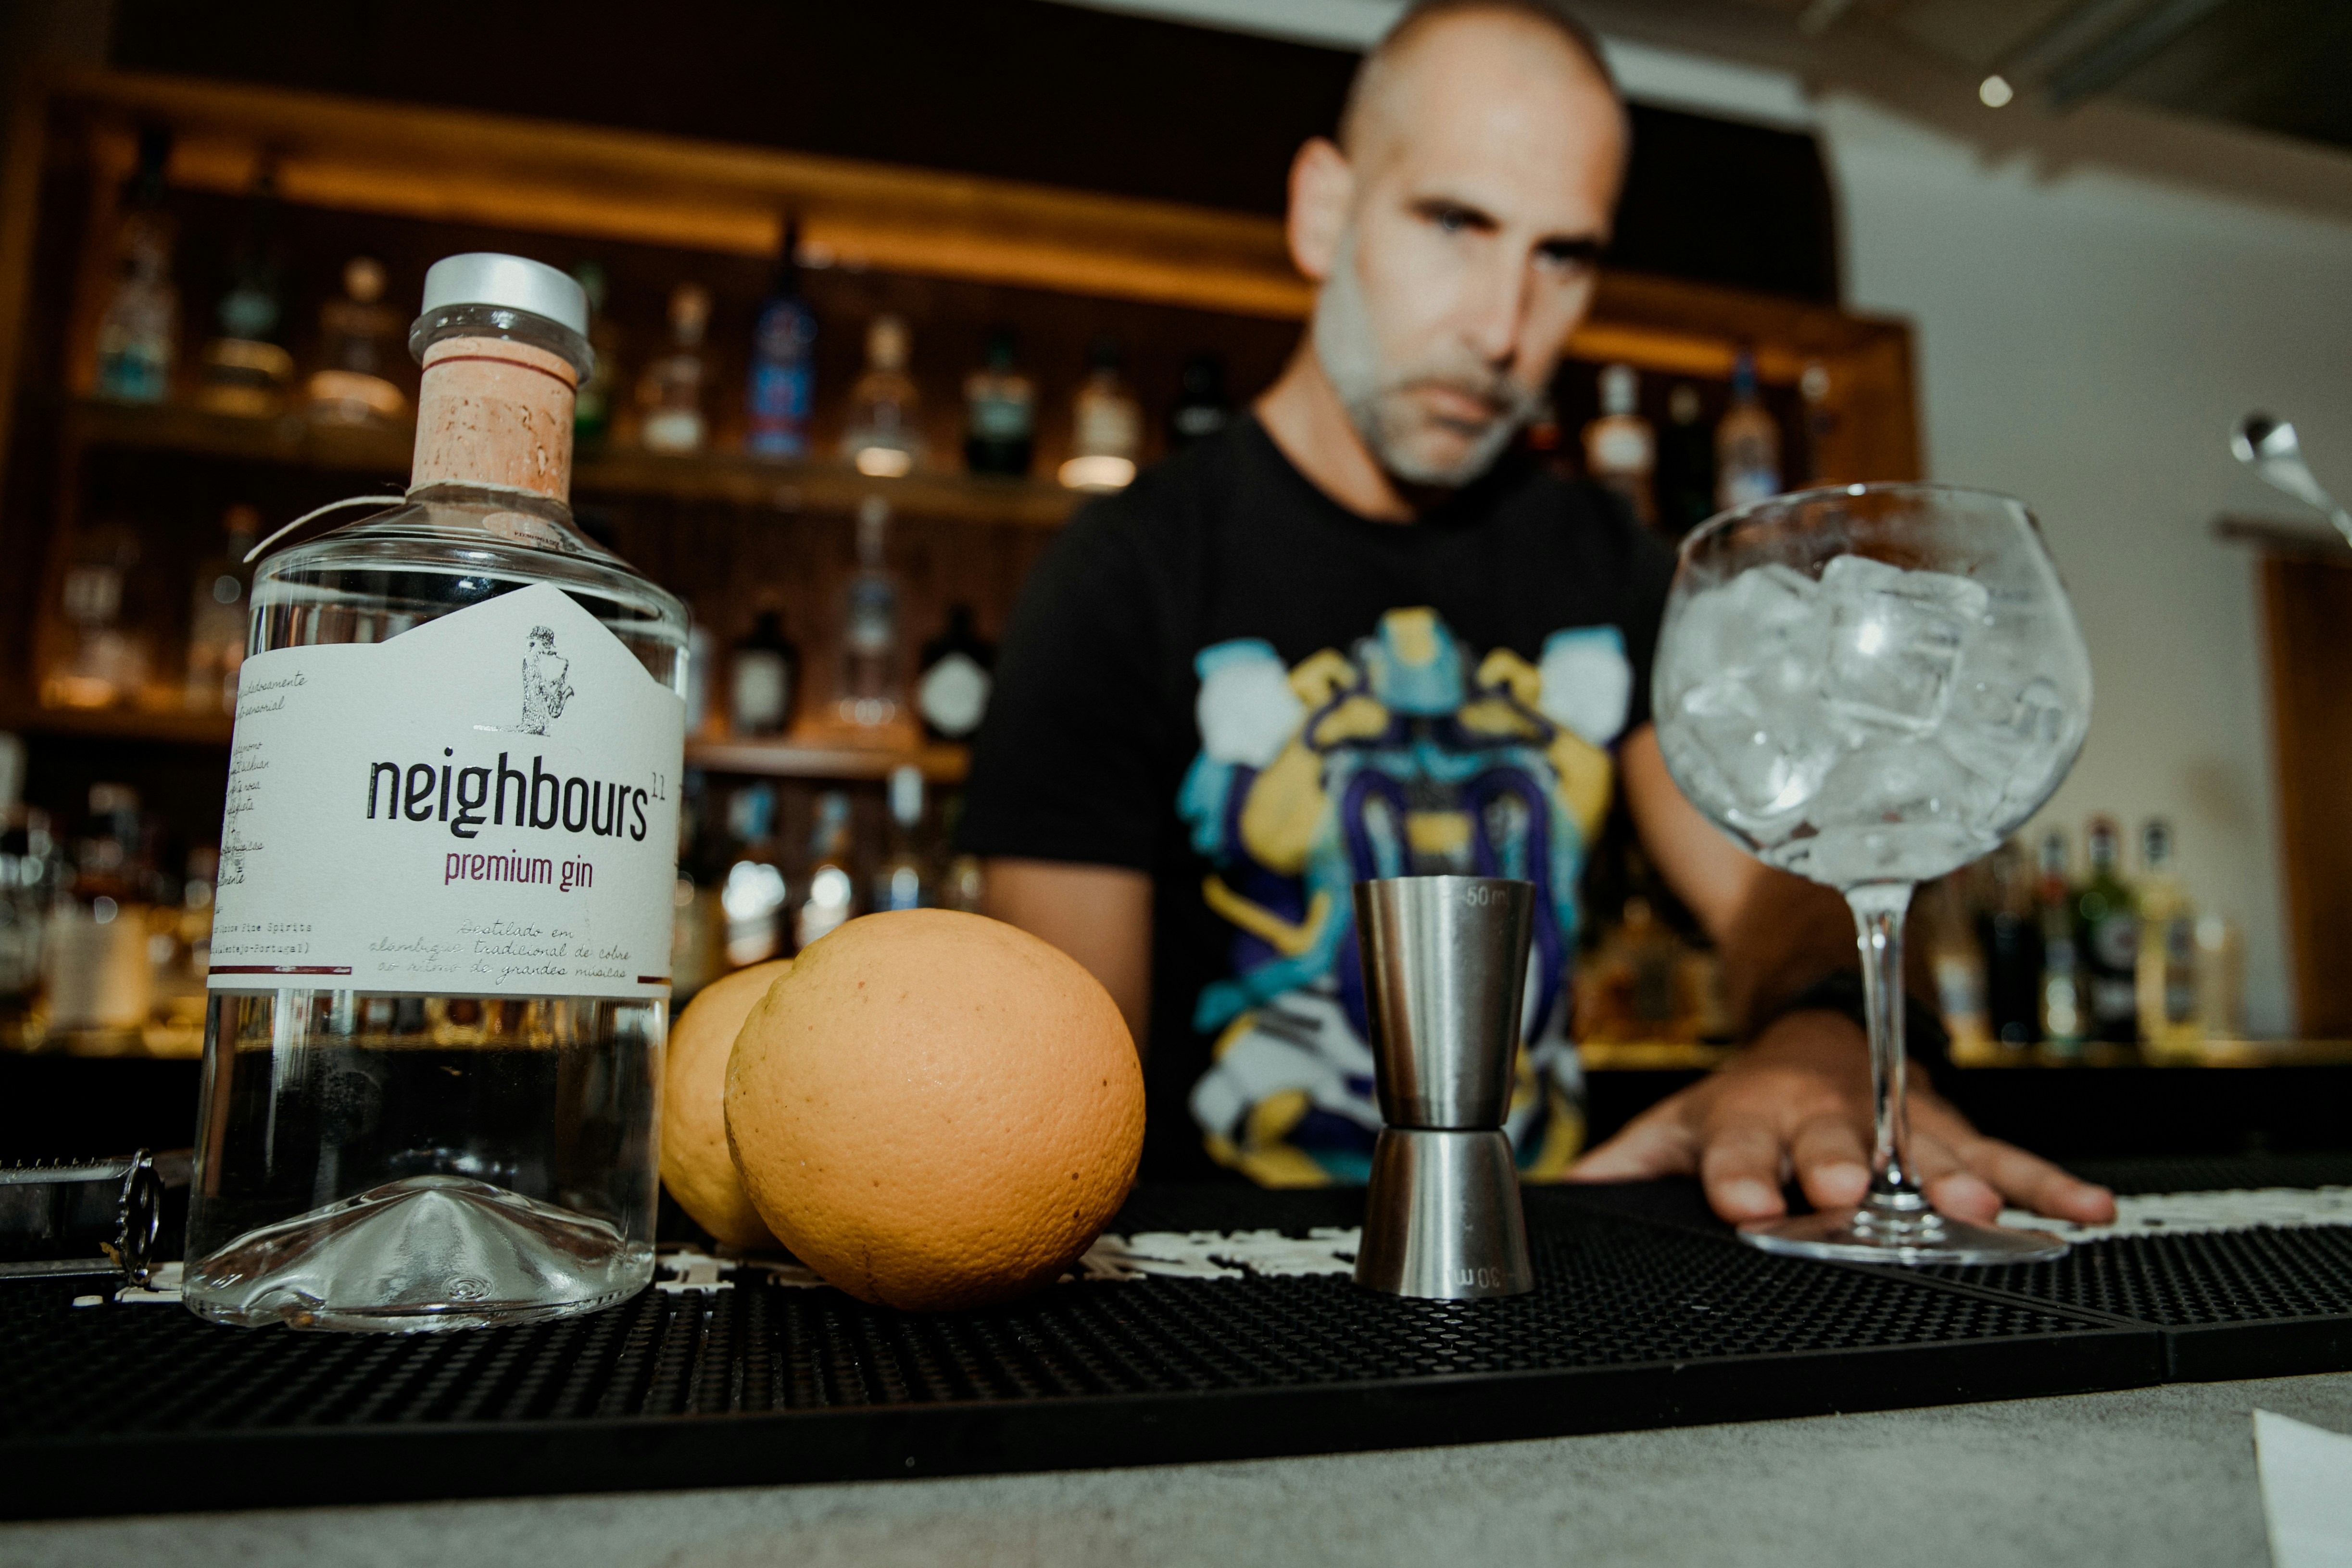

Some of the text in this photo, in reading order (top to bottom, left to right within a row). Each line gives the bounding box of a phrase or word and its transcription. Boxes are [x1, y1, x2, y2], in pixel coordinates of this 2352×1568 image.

[367, 746, 648, 841] neighbours
[444, 849, 593, 892] premium gin
[267, 922, 312, 934] Spirits
[457, 918, 574, 939] Destilado em
[368, 937, 631, 960] alambique tradicional de cobre
[377, 962, 399, 971] ao
[469, 959, 493, 972] de
[496, 961, 568, 985] grandes
